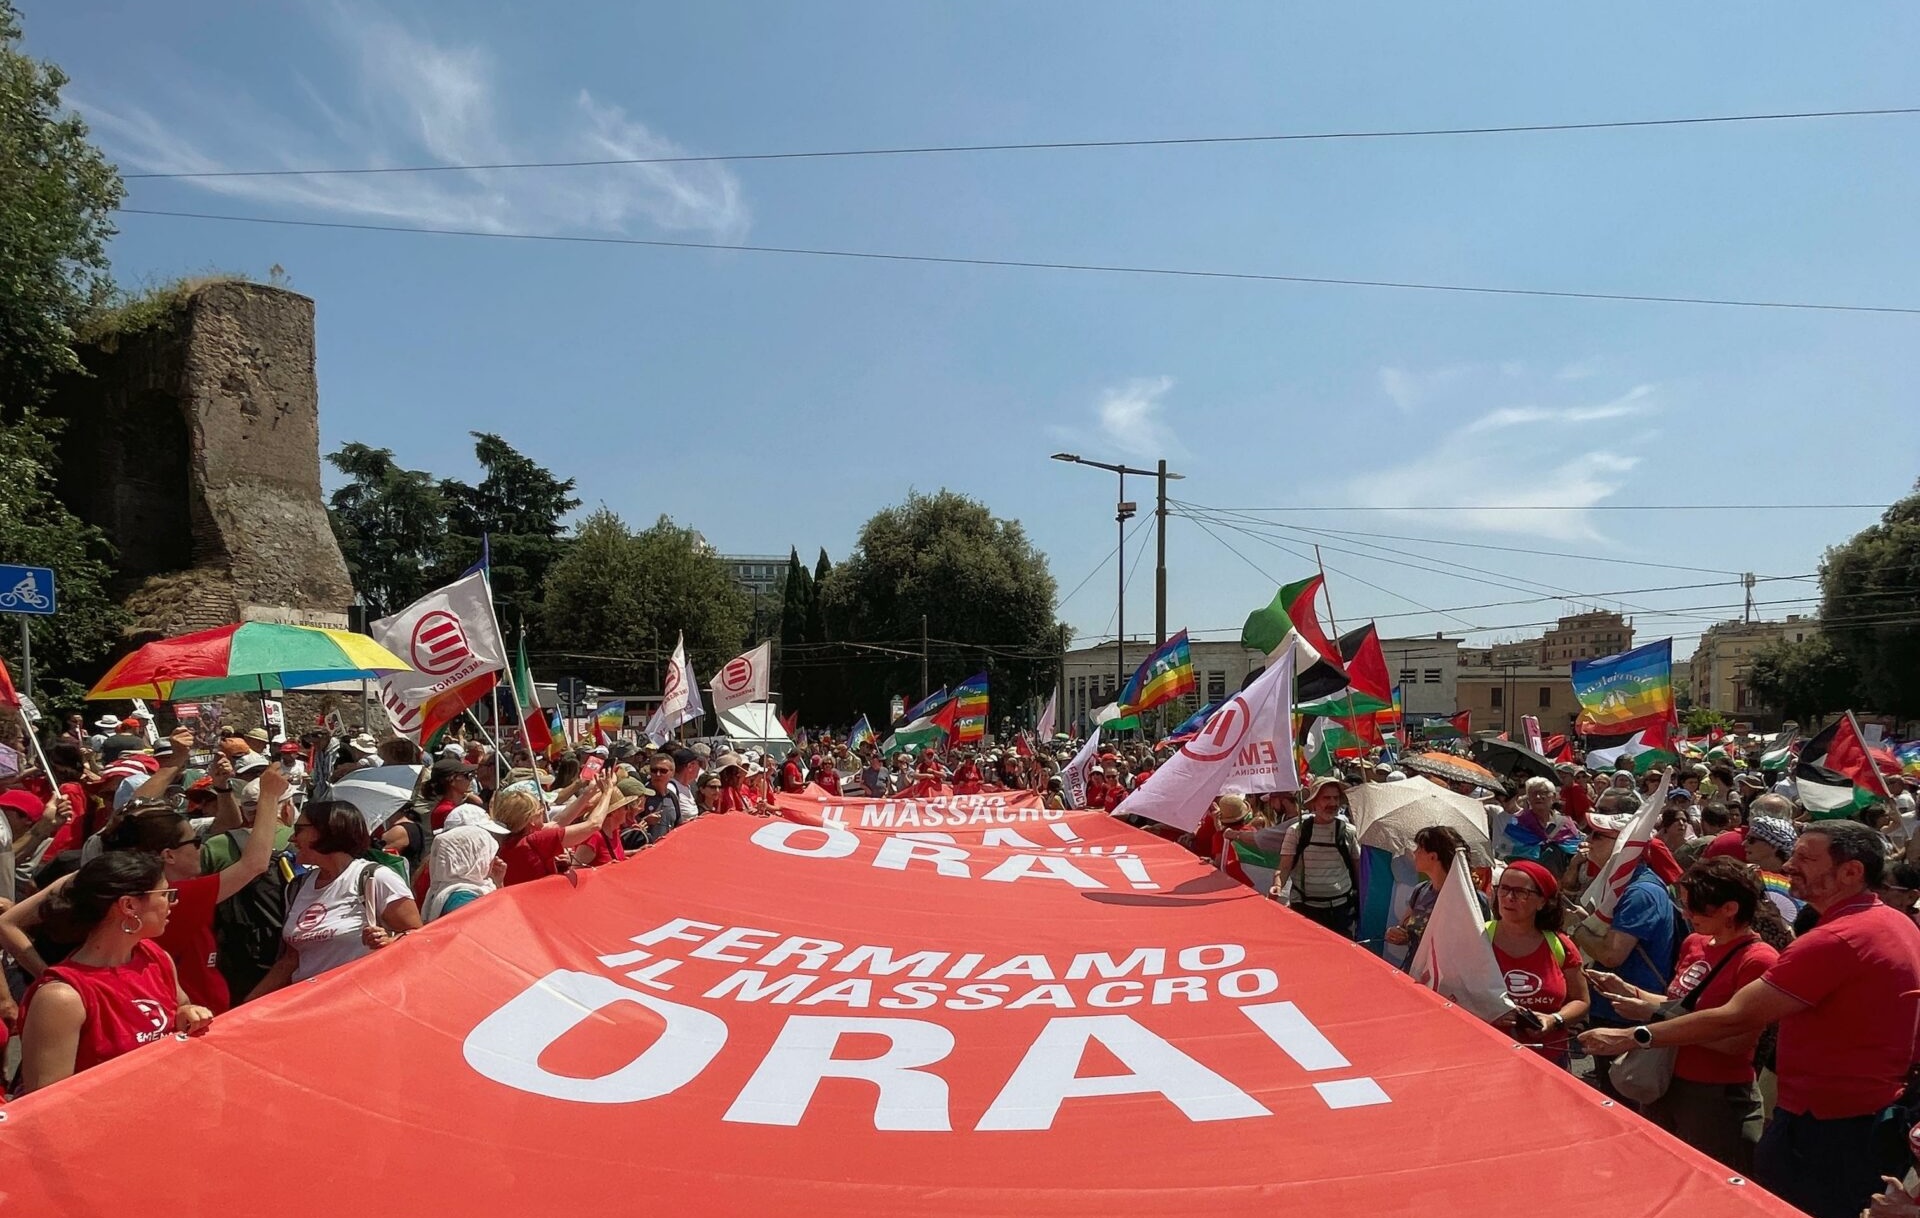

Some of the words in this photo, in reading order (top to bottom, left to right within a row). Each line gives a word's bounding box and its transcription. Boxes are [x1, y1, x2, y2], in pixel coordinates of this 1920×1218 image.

[749, 821, 1161, 889] ORA!
[596, 949, 684, 991] IL
[702, 968, 1279, 1011] MASSACRO
[629, 918, 1246, 980] FERMIAMO
[462, 969, 1393, 1132] ORA!
